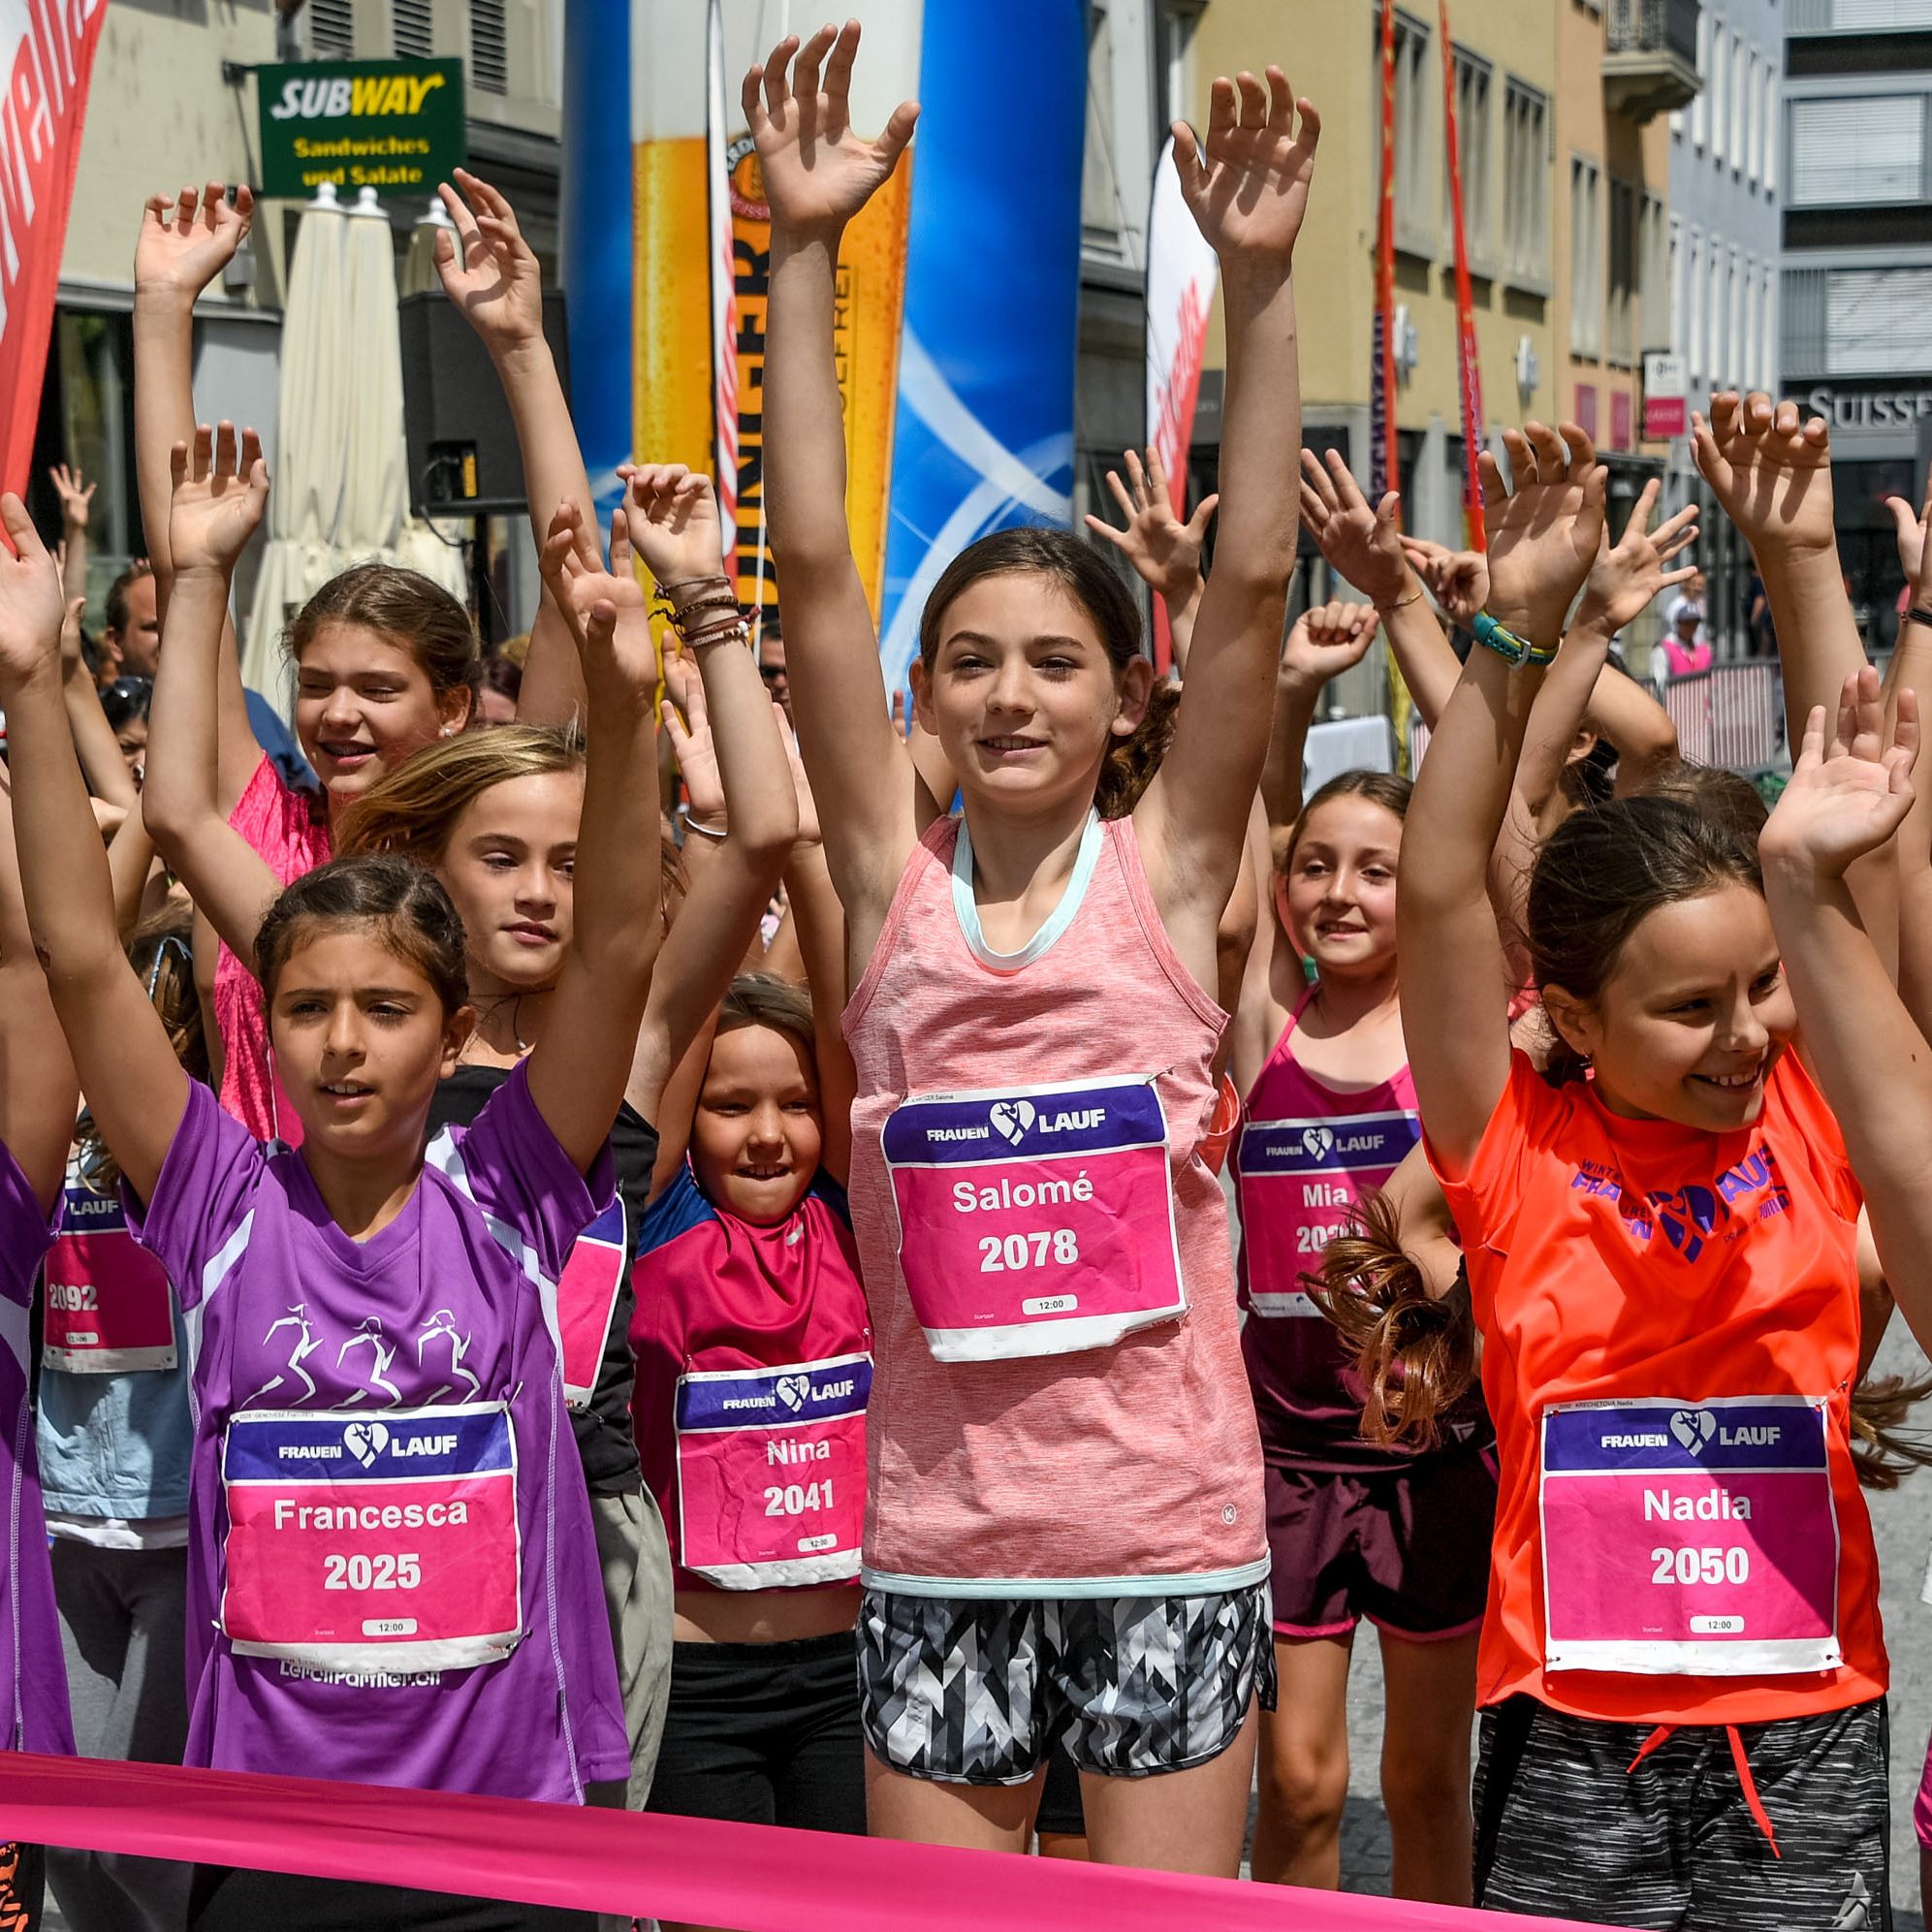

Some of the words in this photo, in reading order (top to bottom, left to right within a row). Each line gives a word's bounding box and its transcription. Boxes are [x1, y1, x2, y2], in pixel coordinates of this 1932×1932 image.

[271, 73, 445, 119] SUBWAY
[294, 138, 429, 157] Sandwiches
[302, 168, 345, 186] und
[350, 165, 423, 185] Salate
[927, 1125, 989, 1141] FRAUEN
[1038, 1108, 1105, 1133] LAUF
[1266, 1146, 1303, 1156] FRAUEN
[1336, 1134, 1384, 1153] LAUF
[952, 1170, 1093, 1212] Salomé
[1302, 1184, 1347, 1208] Mia
[70, 1200, 119, 1215] LAUF
[978, 1228, 1078, 1272] 2078
[49, 1283, 98, 1311] 2092
[1038, 1300, 1064, 1310] 12:00
[722, 1396, 776, 1409] FRAUEN
[810, 1379, 854, 1402] LAUF
[278, 1445, 341, 1459] FRAUEN
[392, 1435, 458, 1457] LAUF
[1601, 1434, 1667, 1447] FRAUEN
[1720, 1426, 1781, 1445] LAUF
[767, 1439, 830, 1466] Nina
[764, 1478, 833, 1516] 2041
[1643, 1488, 1752, 1521] Nadia
[274, 1500, 468, 1530] Francesca
[324, 1553, 422, 1590] 2025
[1650, 1547, 1750, 1585] 2050
[379, 1623, 403, 1632] 12:00
[1707, 1621, 1731, 1630] 12:00
